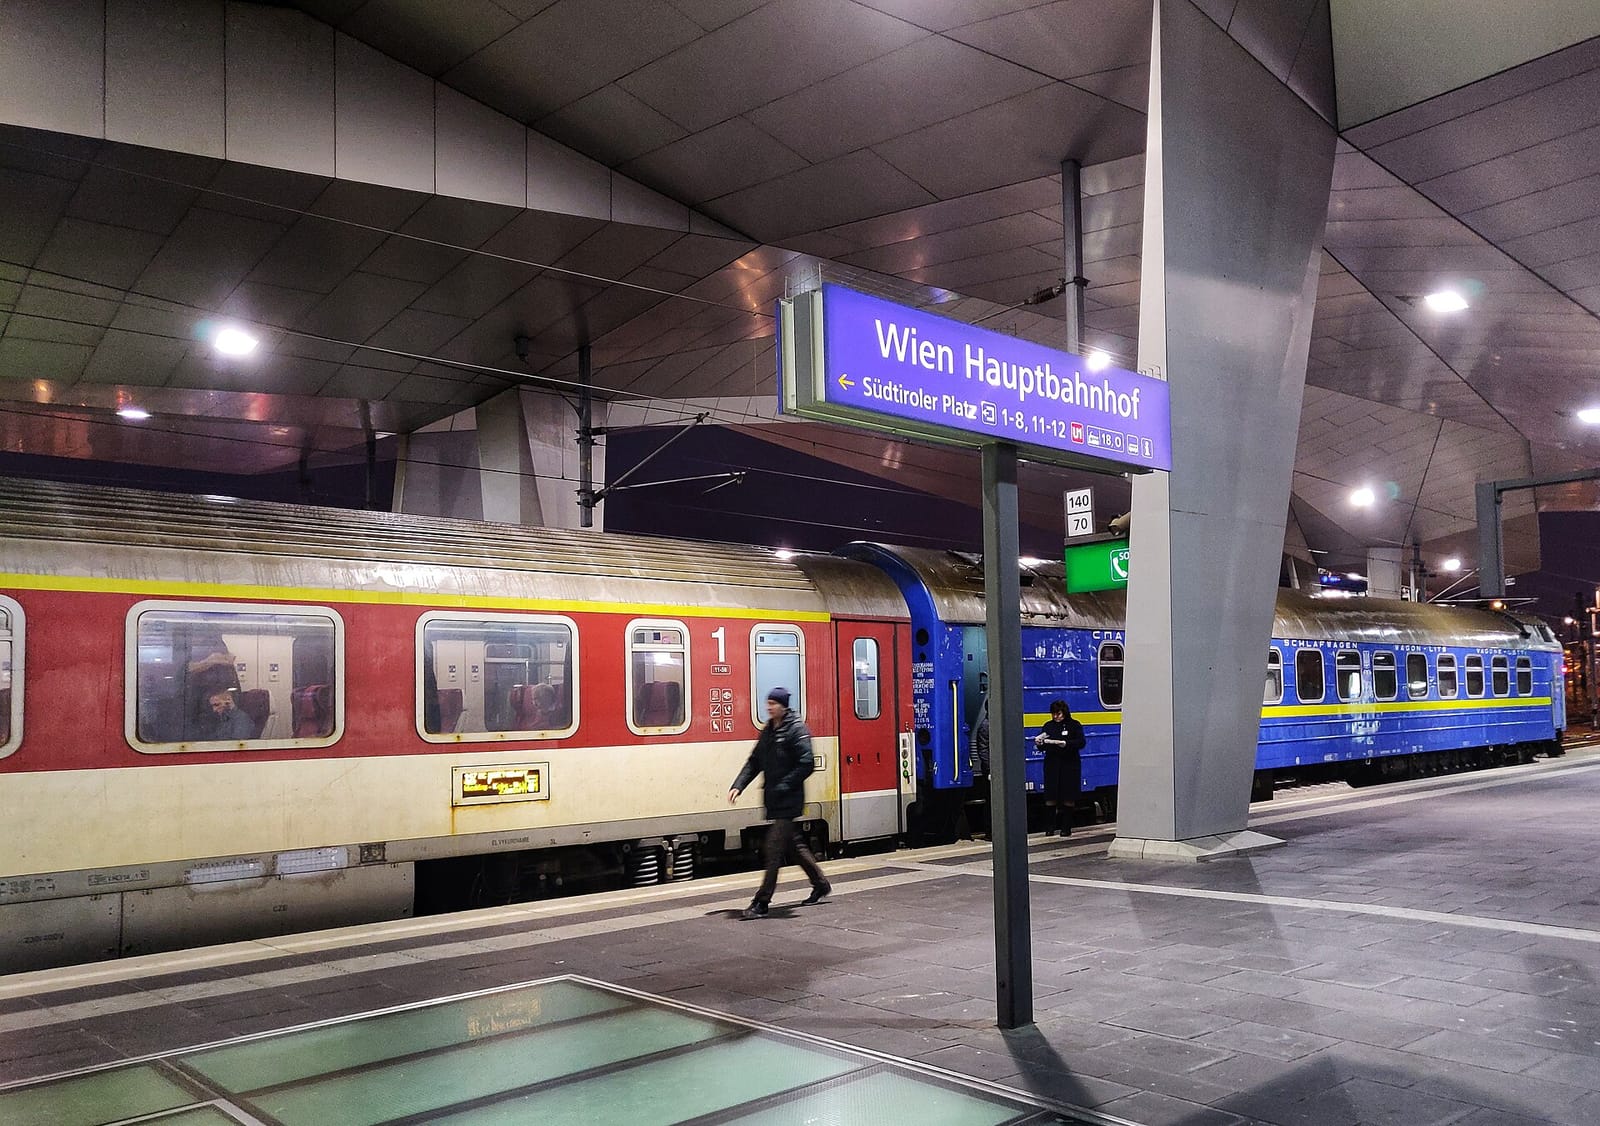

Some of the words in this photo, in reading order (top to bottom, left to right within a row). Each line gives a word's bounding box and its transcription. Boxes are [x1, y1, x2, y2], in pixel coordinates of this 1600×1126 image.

[874, 318, 954, 375] Wien
[964, 342, 1141, 421] Hauptbahnhof
[862, 376, 939, 412] Südtiroler
[942, 394, 978, 420] Platz
[1001, 408, 1029, 433] 1-8,
[1032, 415, 1066, 439] 11-12
[1072, 426, 1083, 441] U1
[1068, 494, 1090, 509] 140
[1073, 517, 1089, 531] 70
[1119, 551, 1130, 561] SO
[1092, 630, 1123, 641] СПА
[711, 626, 726, 663] 1
[1283, 639, 1358, 649] SCHLAFWAGEN
